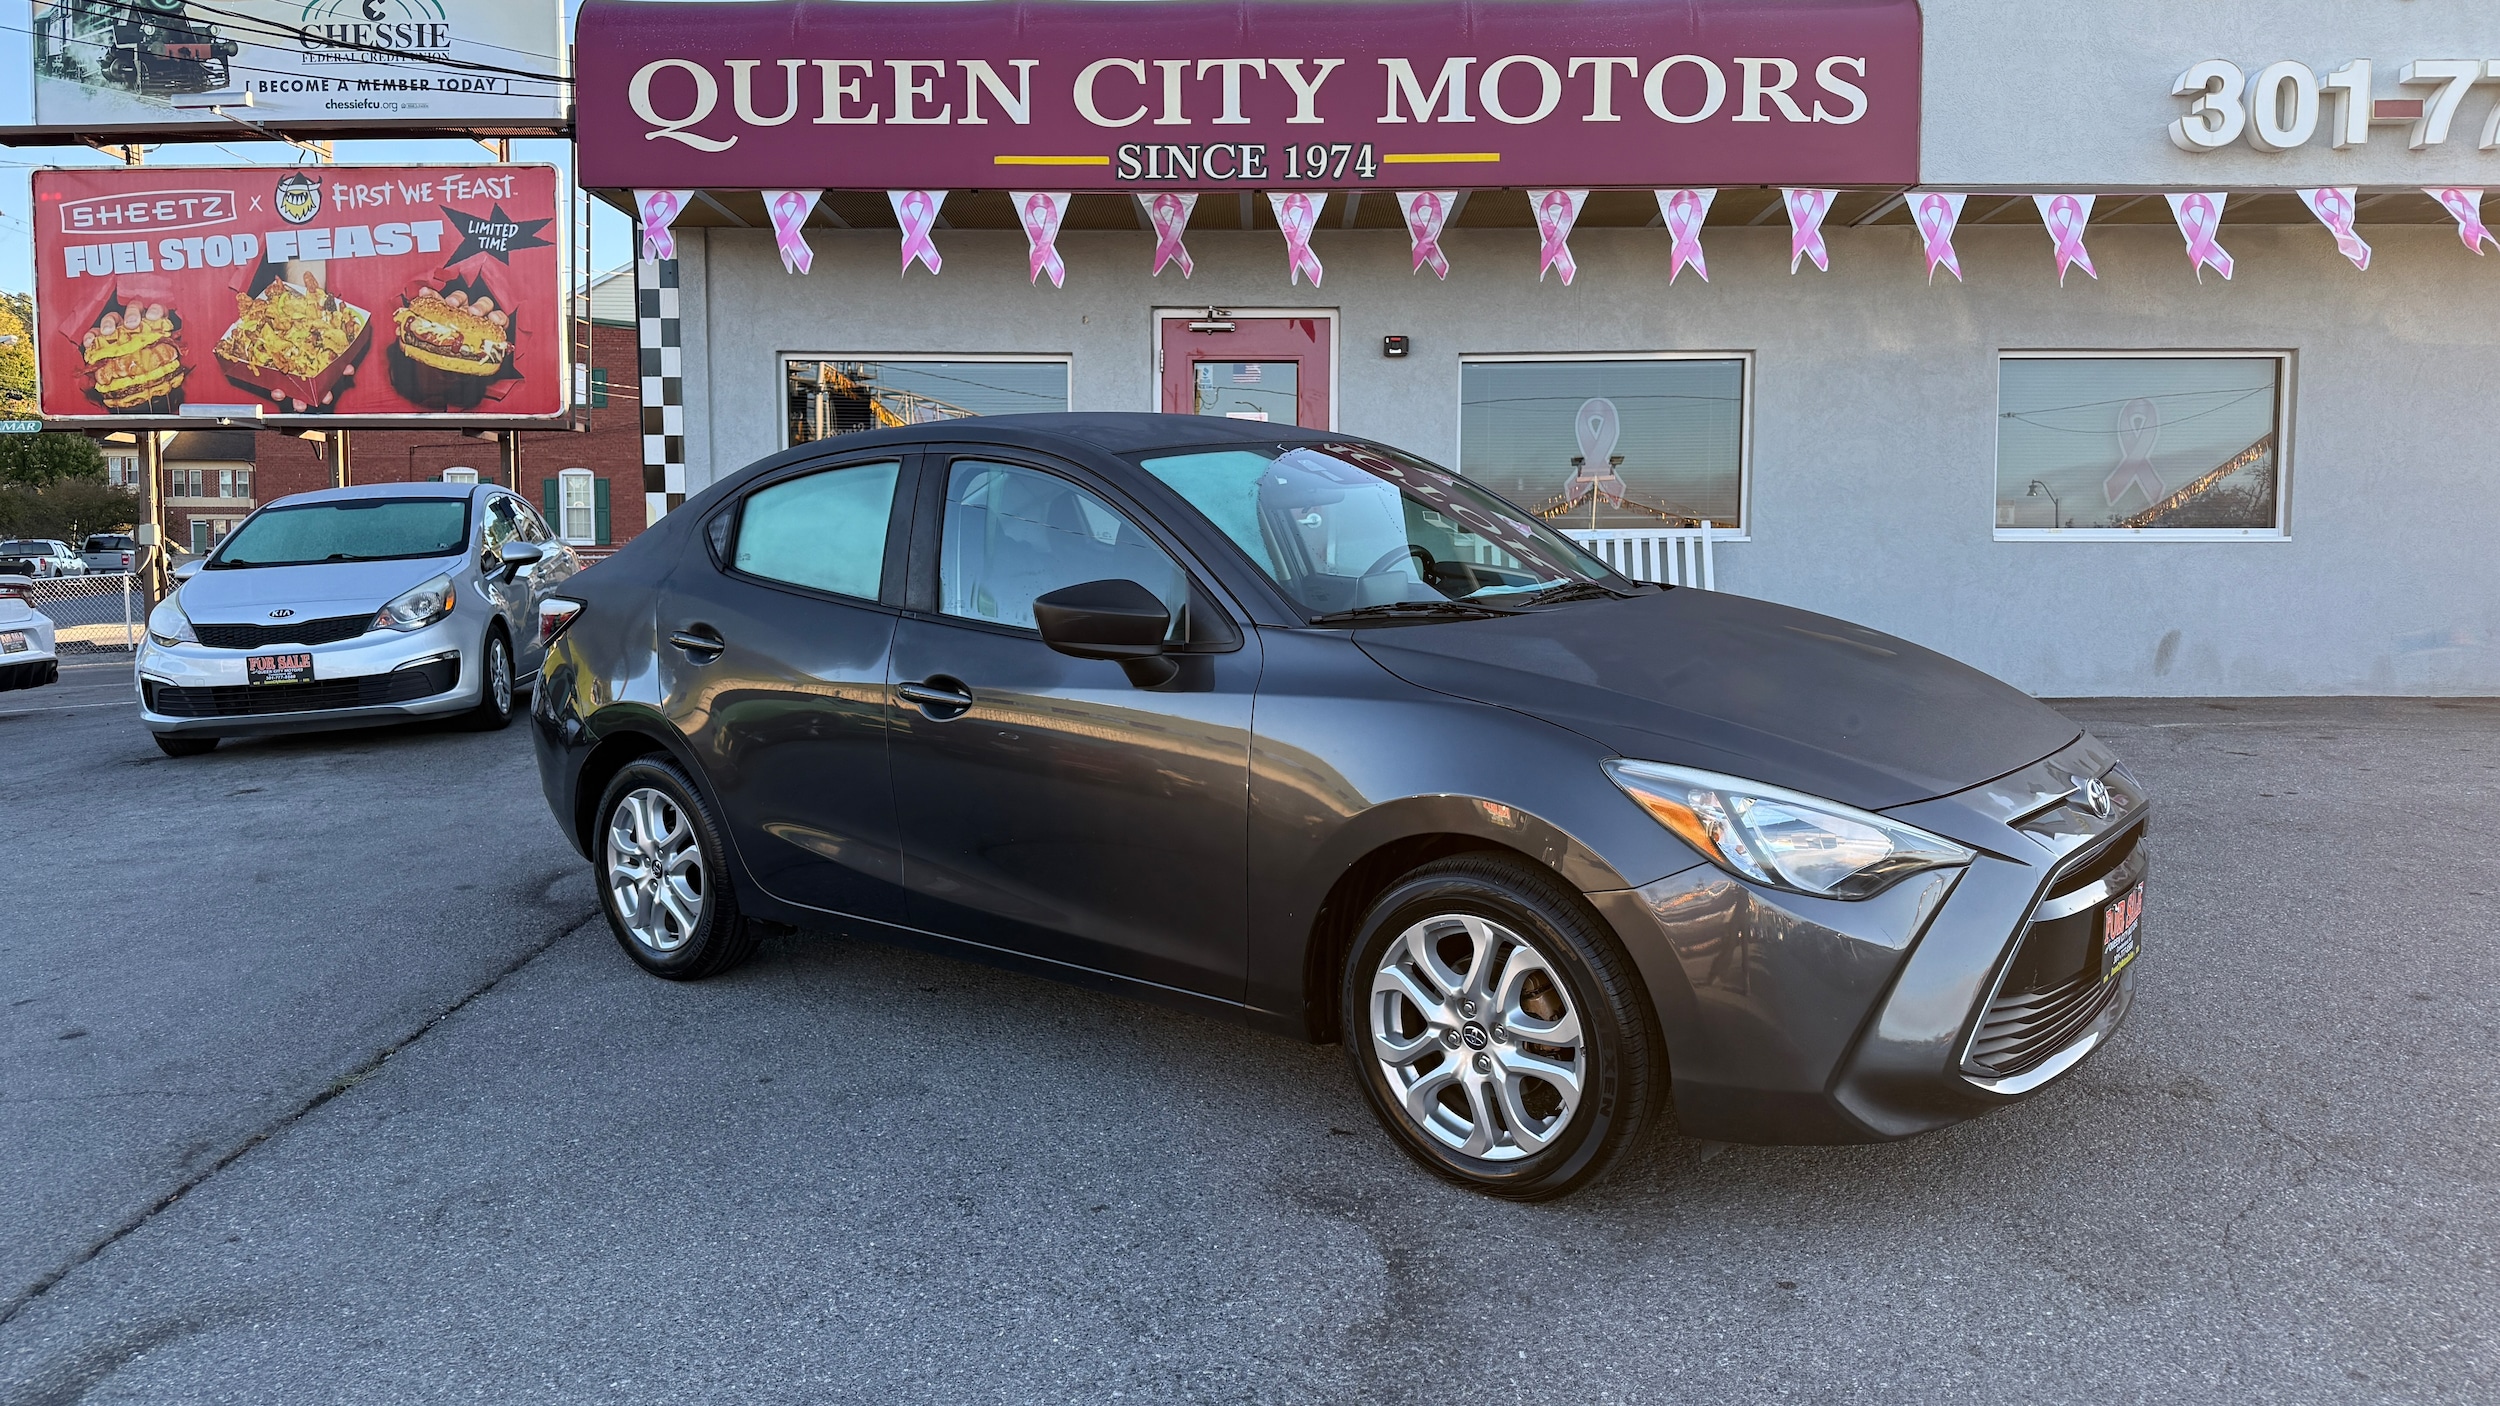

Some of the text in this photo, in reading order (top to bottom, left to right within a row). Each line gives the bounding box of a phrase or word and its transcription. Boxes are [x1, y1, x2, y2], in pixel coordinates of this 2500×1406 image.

[300, 23, 451, 49] CHESSIE
[302, 52, 356, 63] FEDERAL
[409, 52, 450, 62] NION
[259, 79, 329, 92] BECOME
[337, 80, 349, 91] A
[357, 79, 430, 91] MEMBER
[437, 78, 497, 91] TODAY
[325, 98, 398, 112] chessiefcu.org
[627, 55, 1868, 153] QUEEN CITY MOTORS
[2168, 58, 2500, 152] 301-7
[1115, 142, 1377, 181] SINCE 1974
[72, 197, 223, 228] SHEETZ
[332, 181, 394, 212] FIRST
[397, 179, 434, 205] WE
[436, 174, 515, 202] FEAST
[468, 220, 519, 238] LIMITED
[63, 219, 444, 278] FUEL STOP FEAST
[478, 236, 508, 251] TIME
[0, 422, 36, 431] MAR
[271, 609, 291, 617] KIA
[248, 654, 311, 671] FOR SALE
